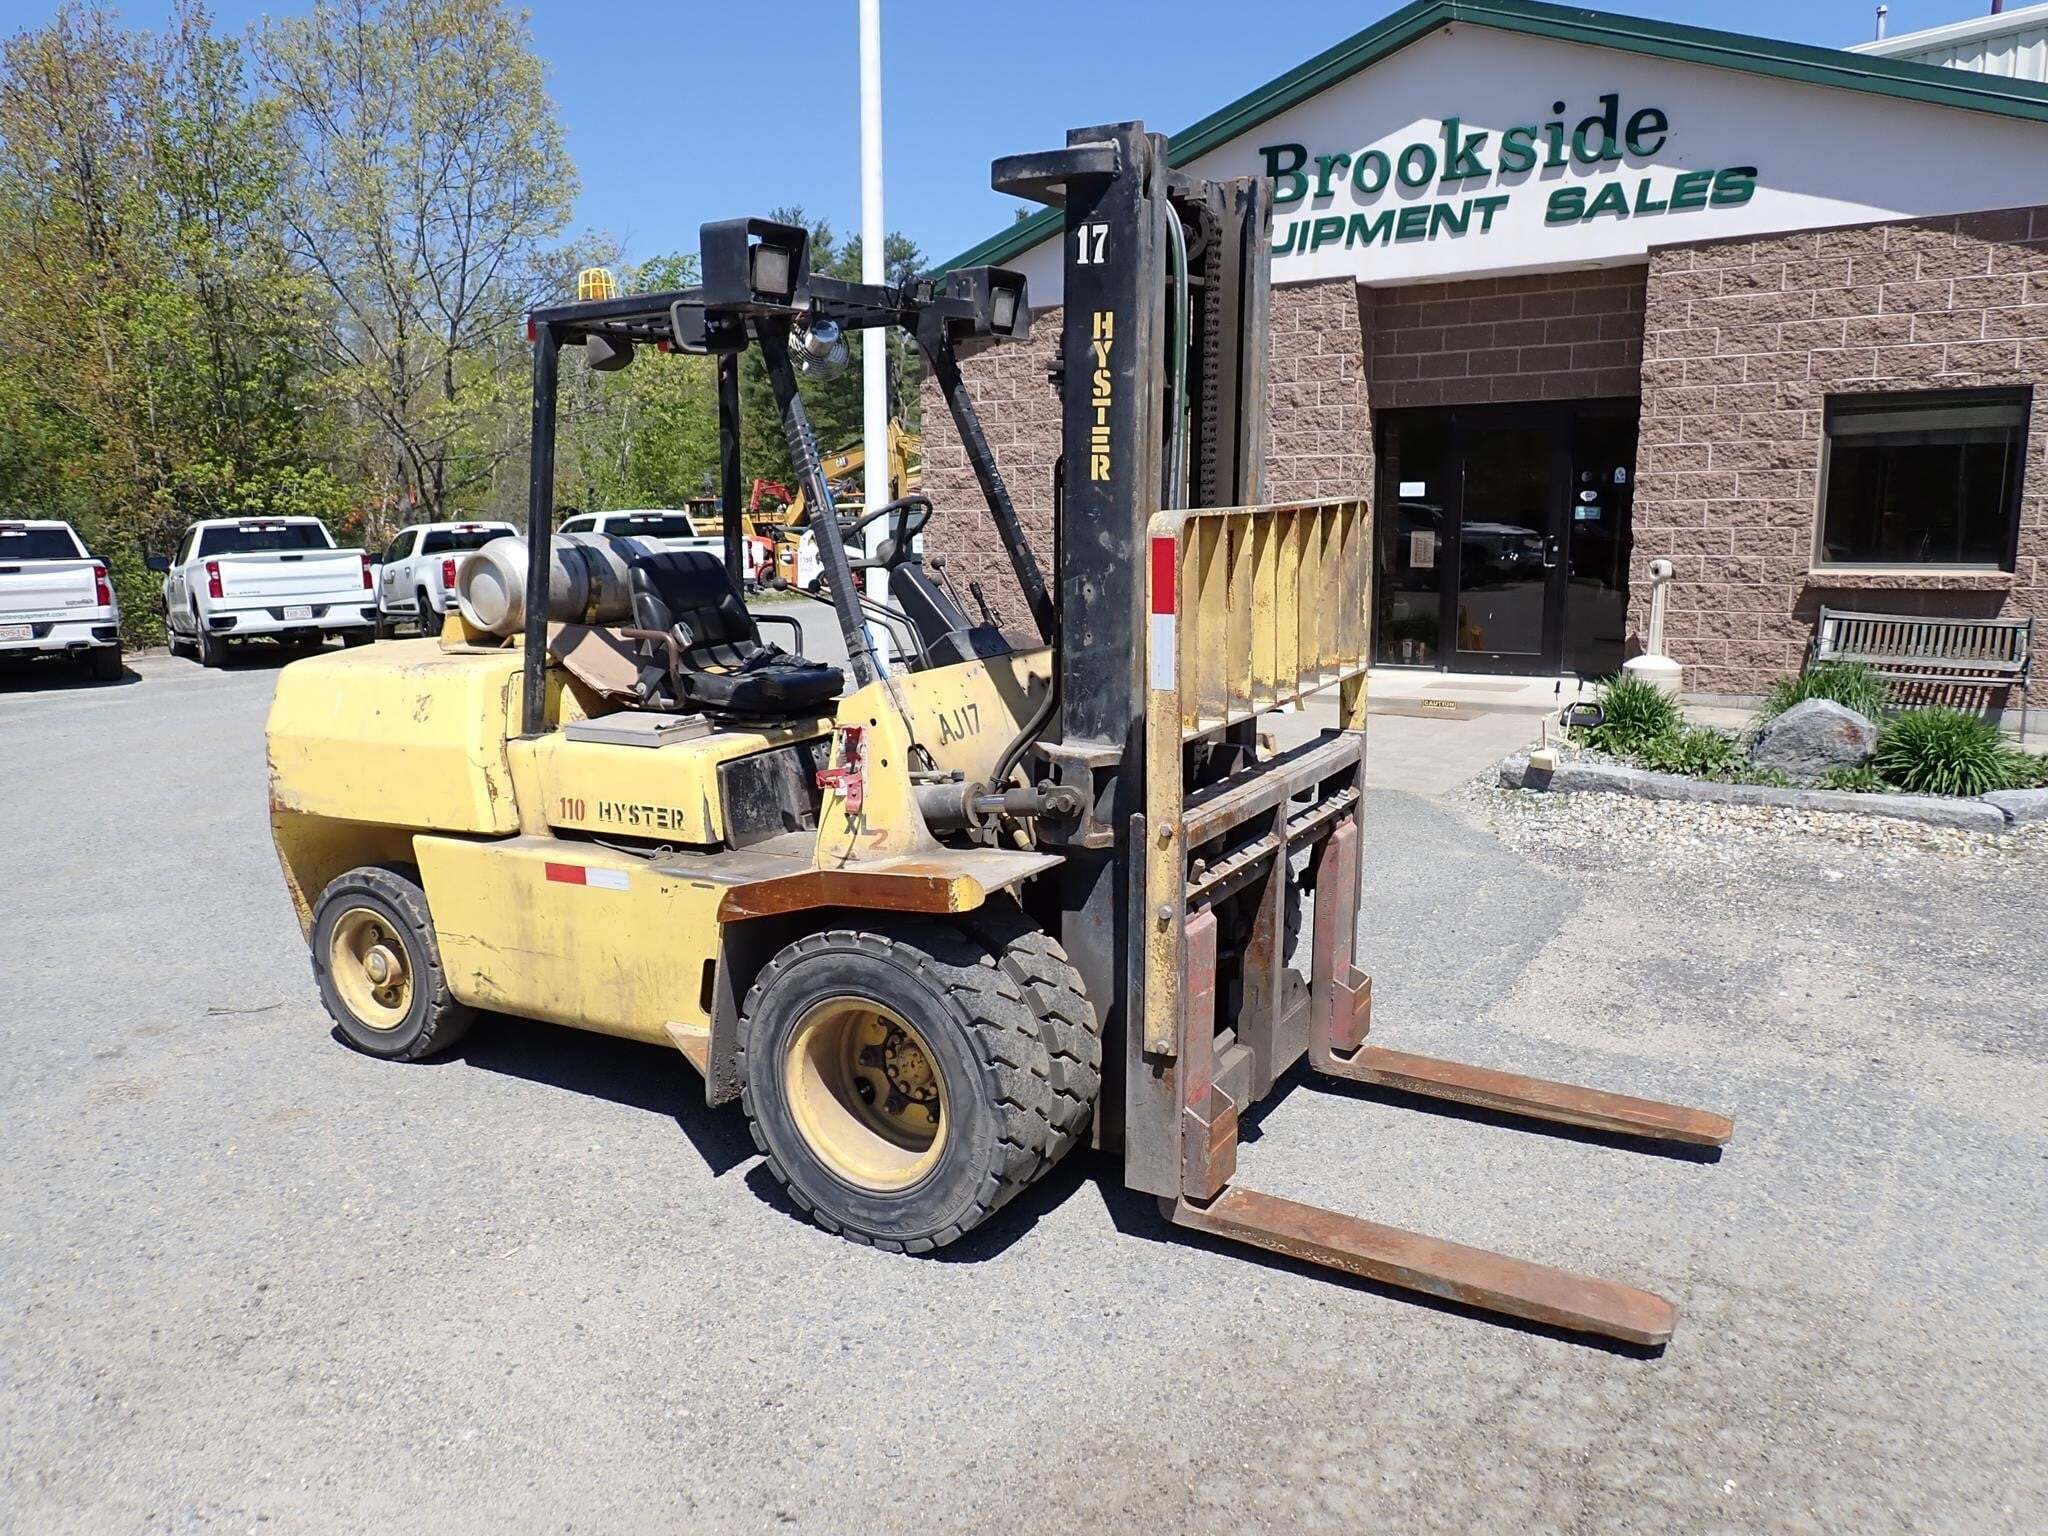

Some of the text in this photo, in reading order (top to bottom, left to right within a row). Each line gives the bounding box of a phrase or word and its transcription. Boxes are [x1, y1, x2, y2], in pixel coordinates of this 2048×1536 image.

[1259, 94, 1669, 203] Brookside
[1545, 166, 1758, 222] SALES
[1076, 224, 1108, 265] 17
[1090, 311, 1114, 481] HYSTER
[939, 703, 981, 746] AJ17
[559, 797, 684, 829] 110 HYSTER
[844, 812, 889, 850] XL 2
